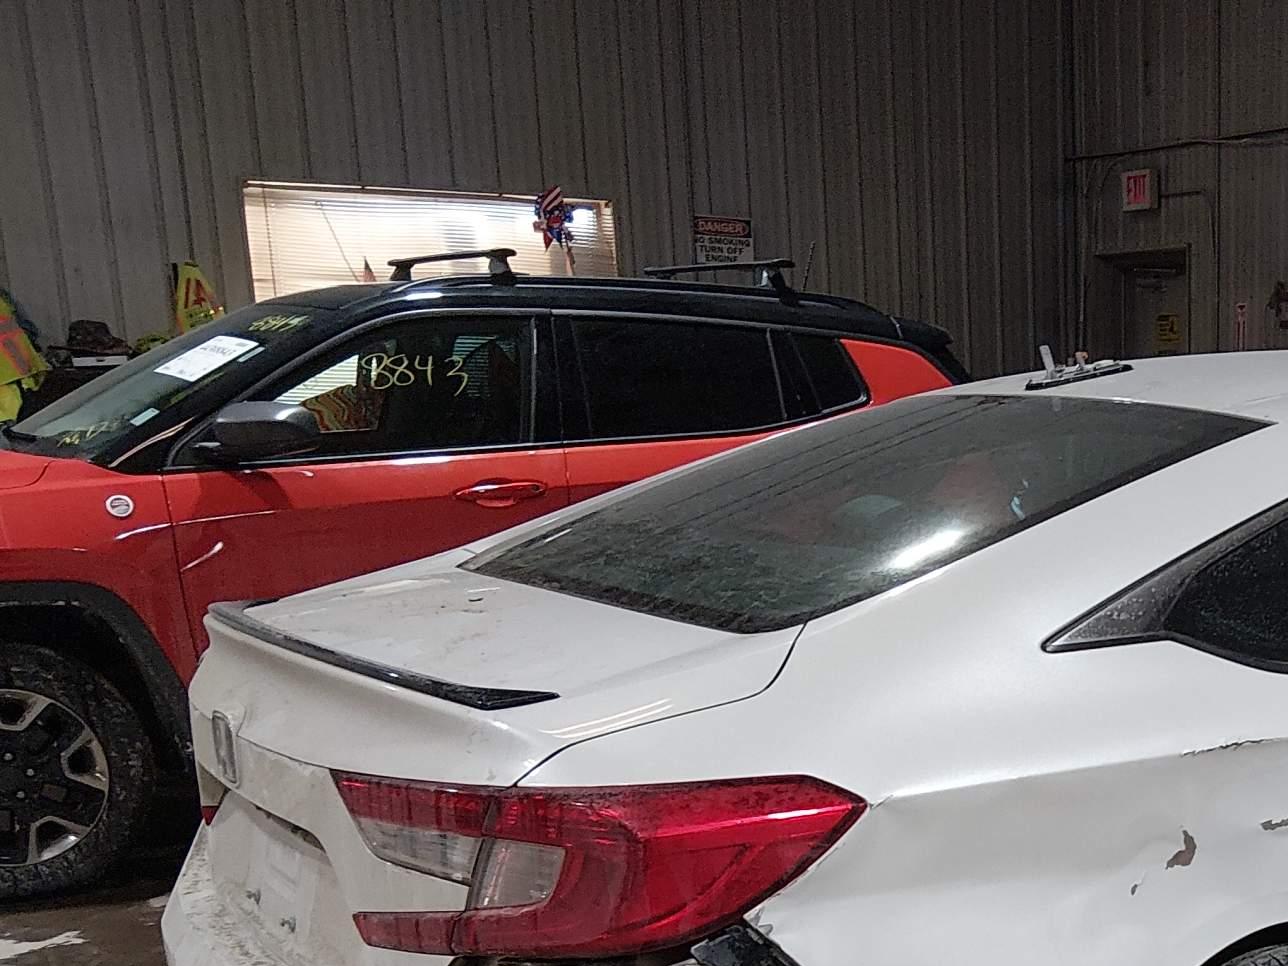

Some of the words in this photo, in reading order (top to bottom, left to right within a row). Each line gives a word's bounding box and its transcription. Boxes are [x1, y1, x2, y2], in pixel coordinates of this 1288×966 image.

[699, 221, 745, 234] DANGER
[708, 236, 750, 247] SMOKING
[699, 244, 724, 254] TURN
[726, 246, 745, 255] OFF
[705, 253, 738, 262] ENGINE
